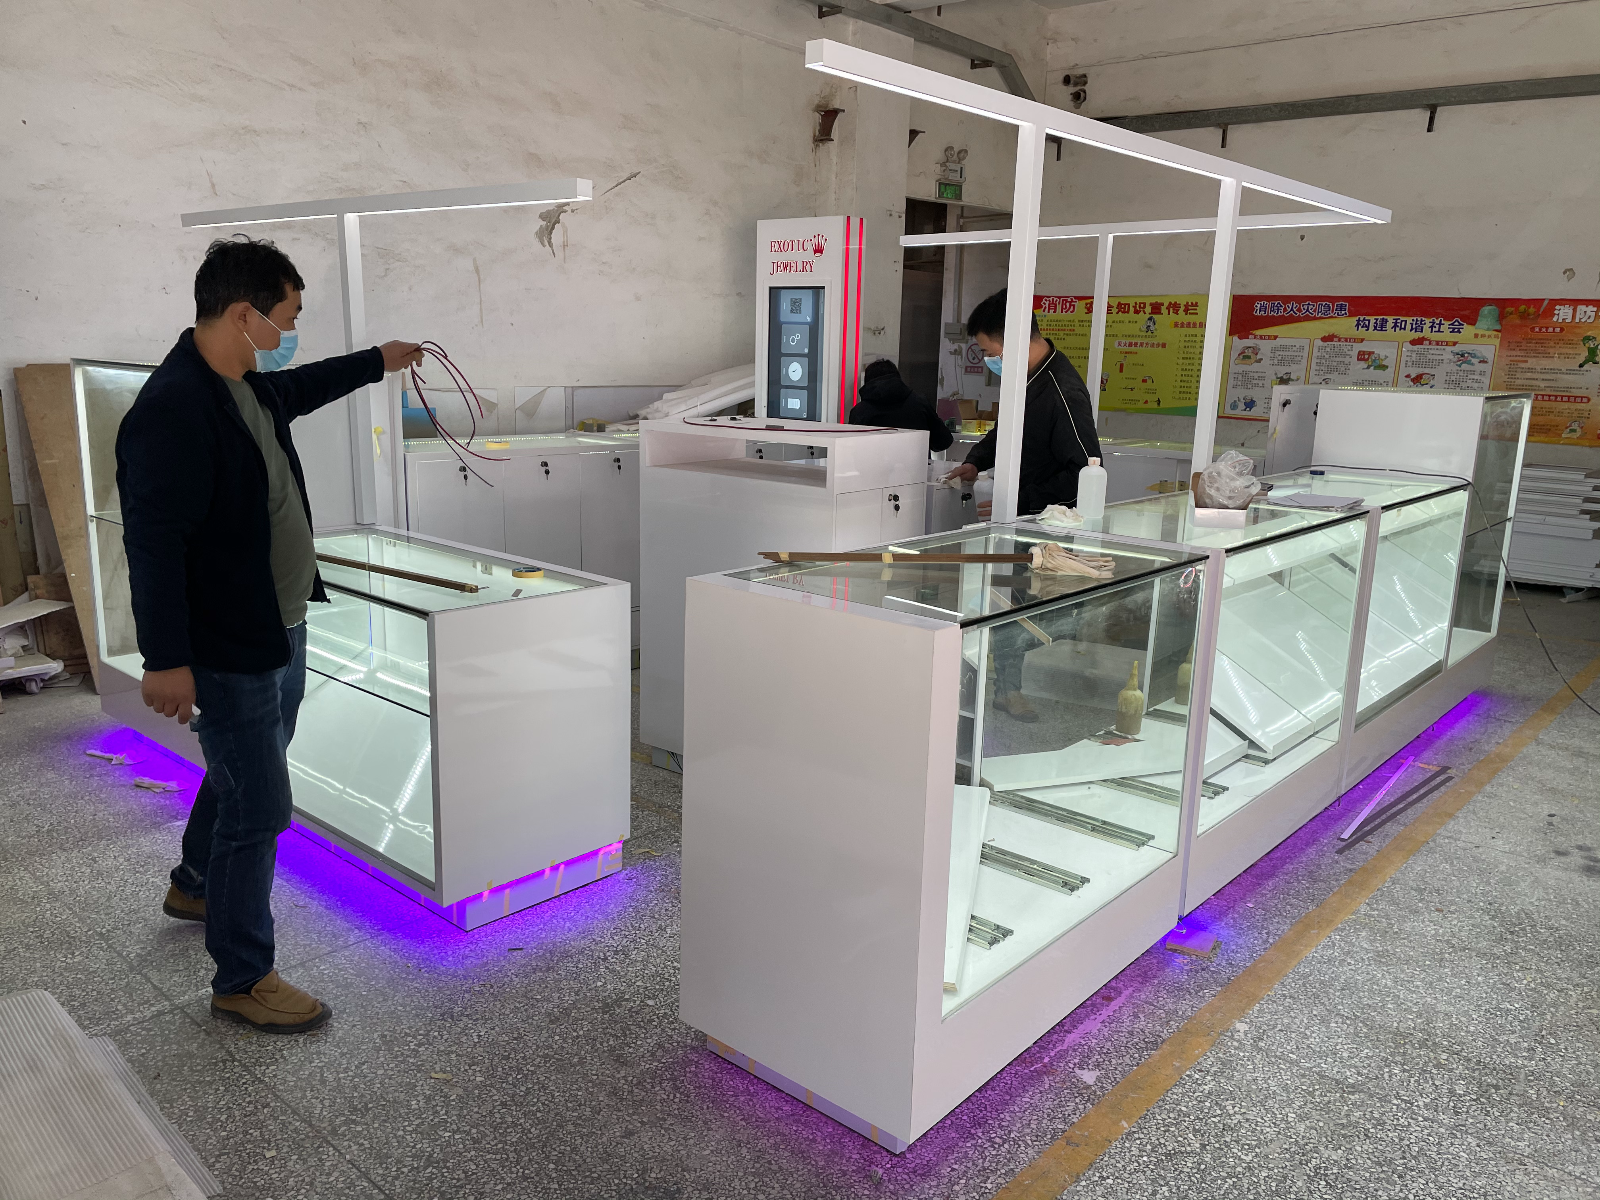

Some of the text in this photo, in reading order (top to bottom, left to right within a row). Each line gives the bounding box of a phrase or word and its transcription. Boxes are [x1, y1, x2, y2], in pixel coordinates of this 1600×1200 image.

[770, 239, 809, 253] EXOTIC
[769, 260, 815, 276] JEWELRY
[1041, 297, 1079, 315] 消防
[1253, 301, 1349, 317] 消除火灾隐患
[1552, 304, 1598, 323] 消防
[1354, 317, 1466, 335] 构建和谐社会
